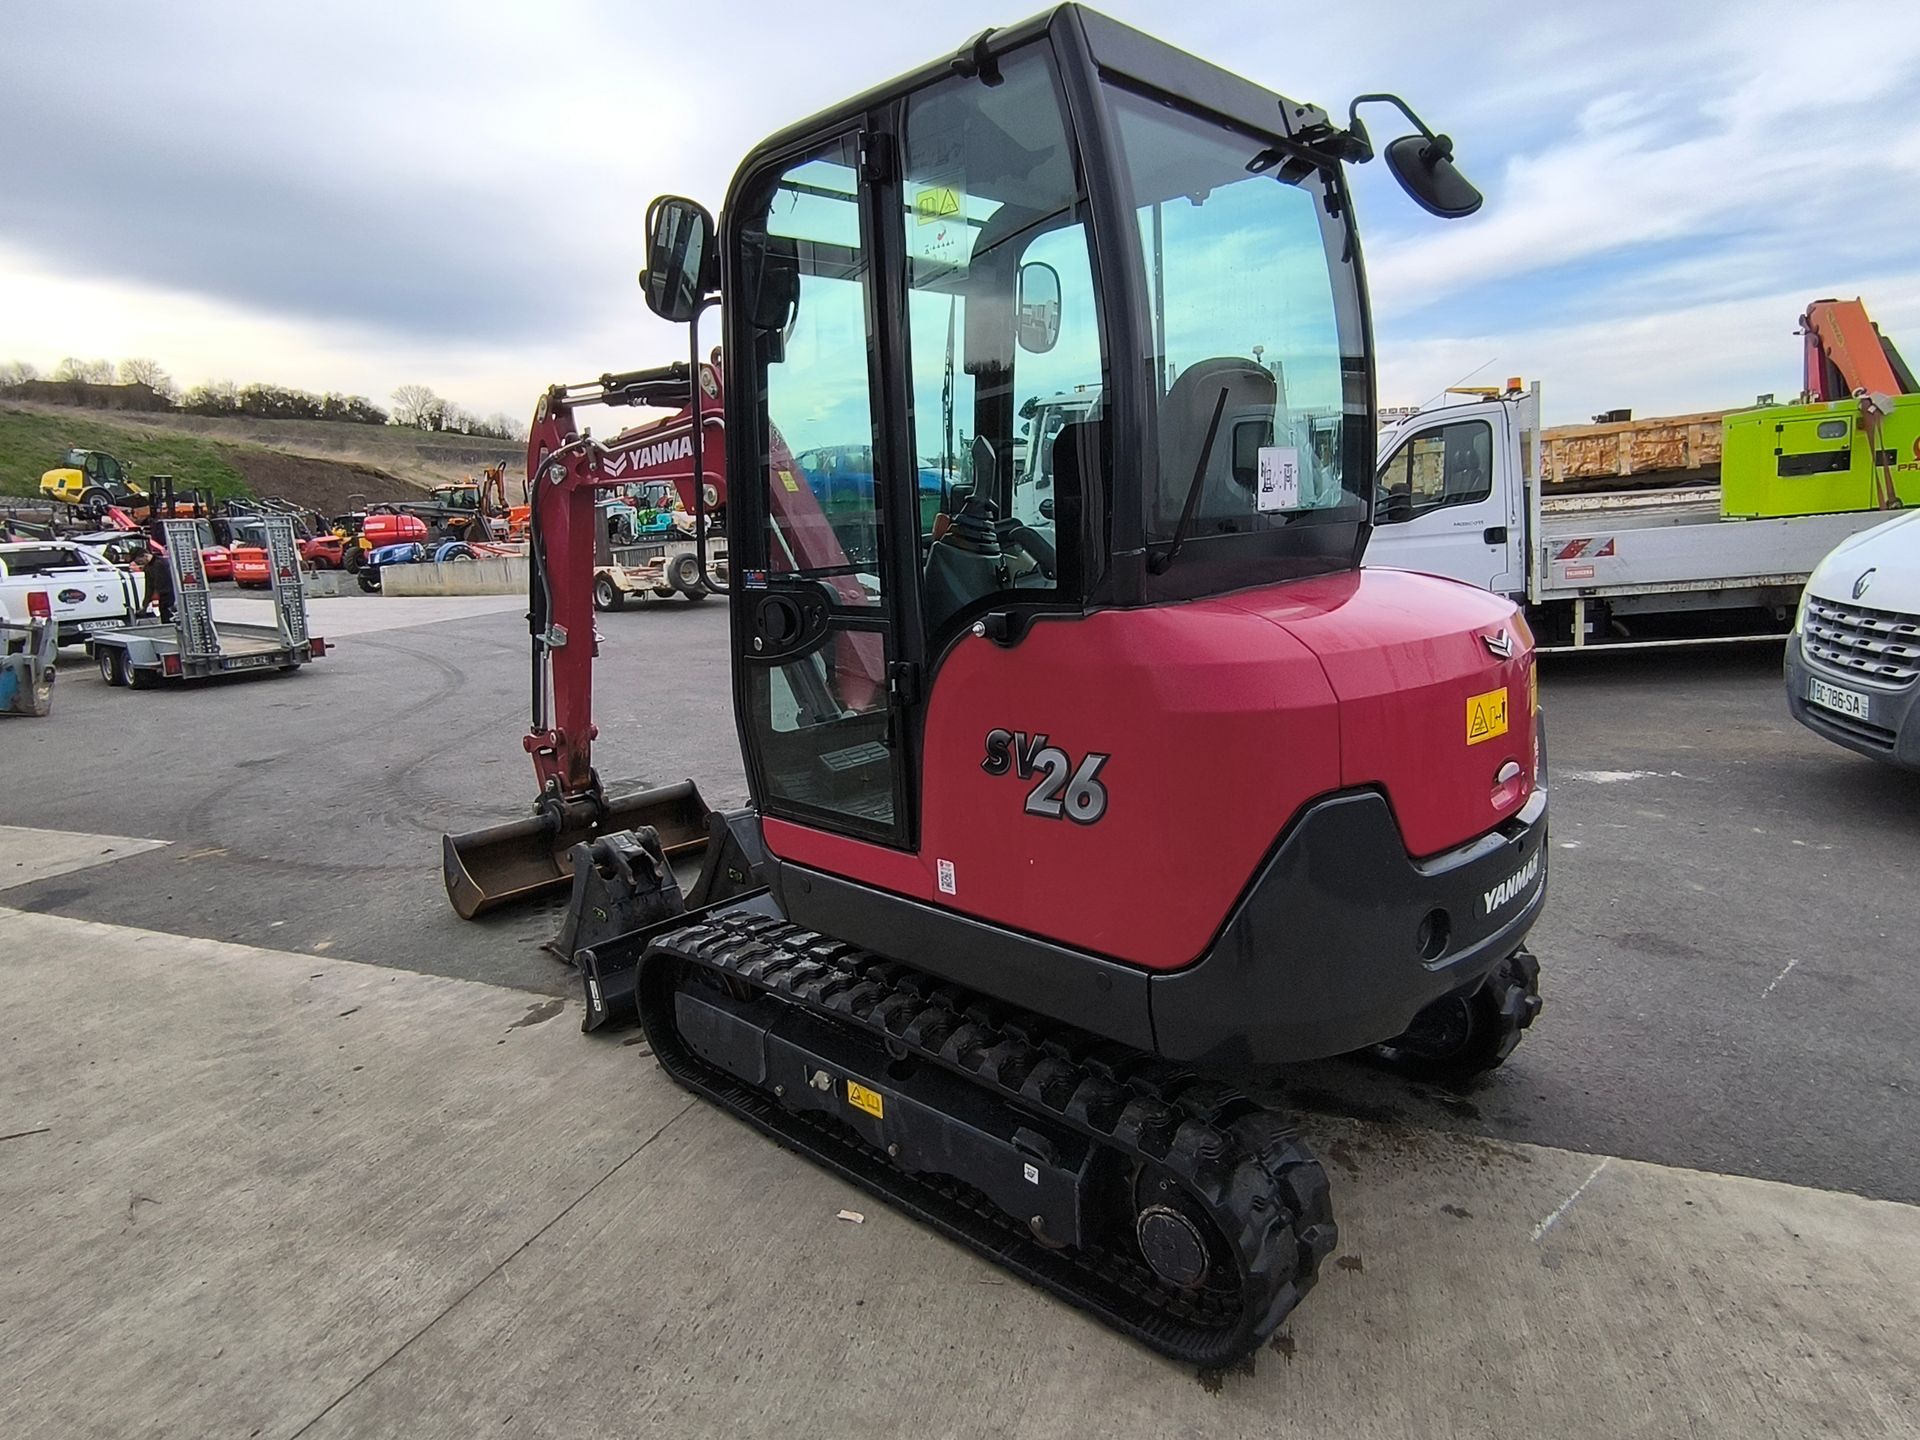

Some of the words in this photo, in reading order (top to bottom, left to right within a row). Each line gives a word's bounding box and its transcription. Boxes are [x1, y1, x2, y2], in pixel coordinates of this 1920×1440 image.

[629, 433, 704, 470] YANMA
[1897, 462, 1920, 471] PR
[1816, 683, 1860, 714] BC-786-SA
[1484, 852, 1539, 915] YANMAR
